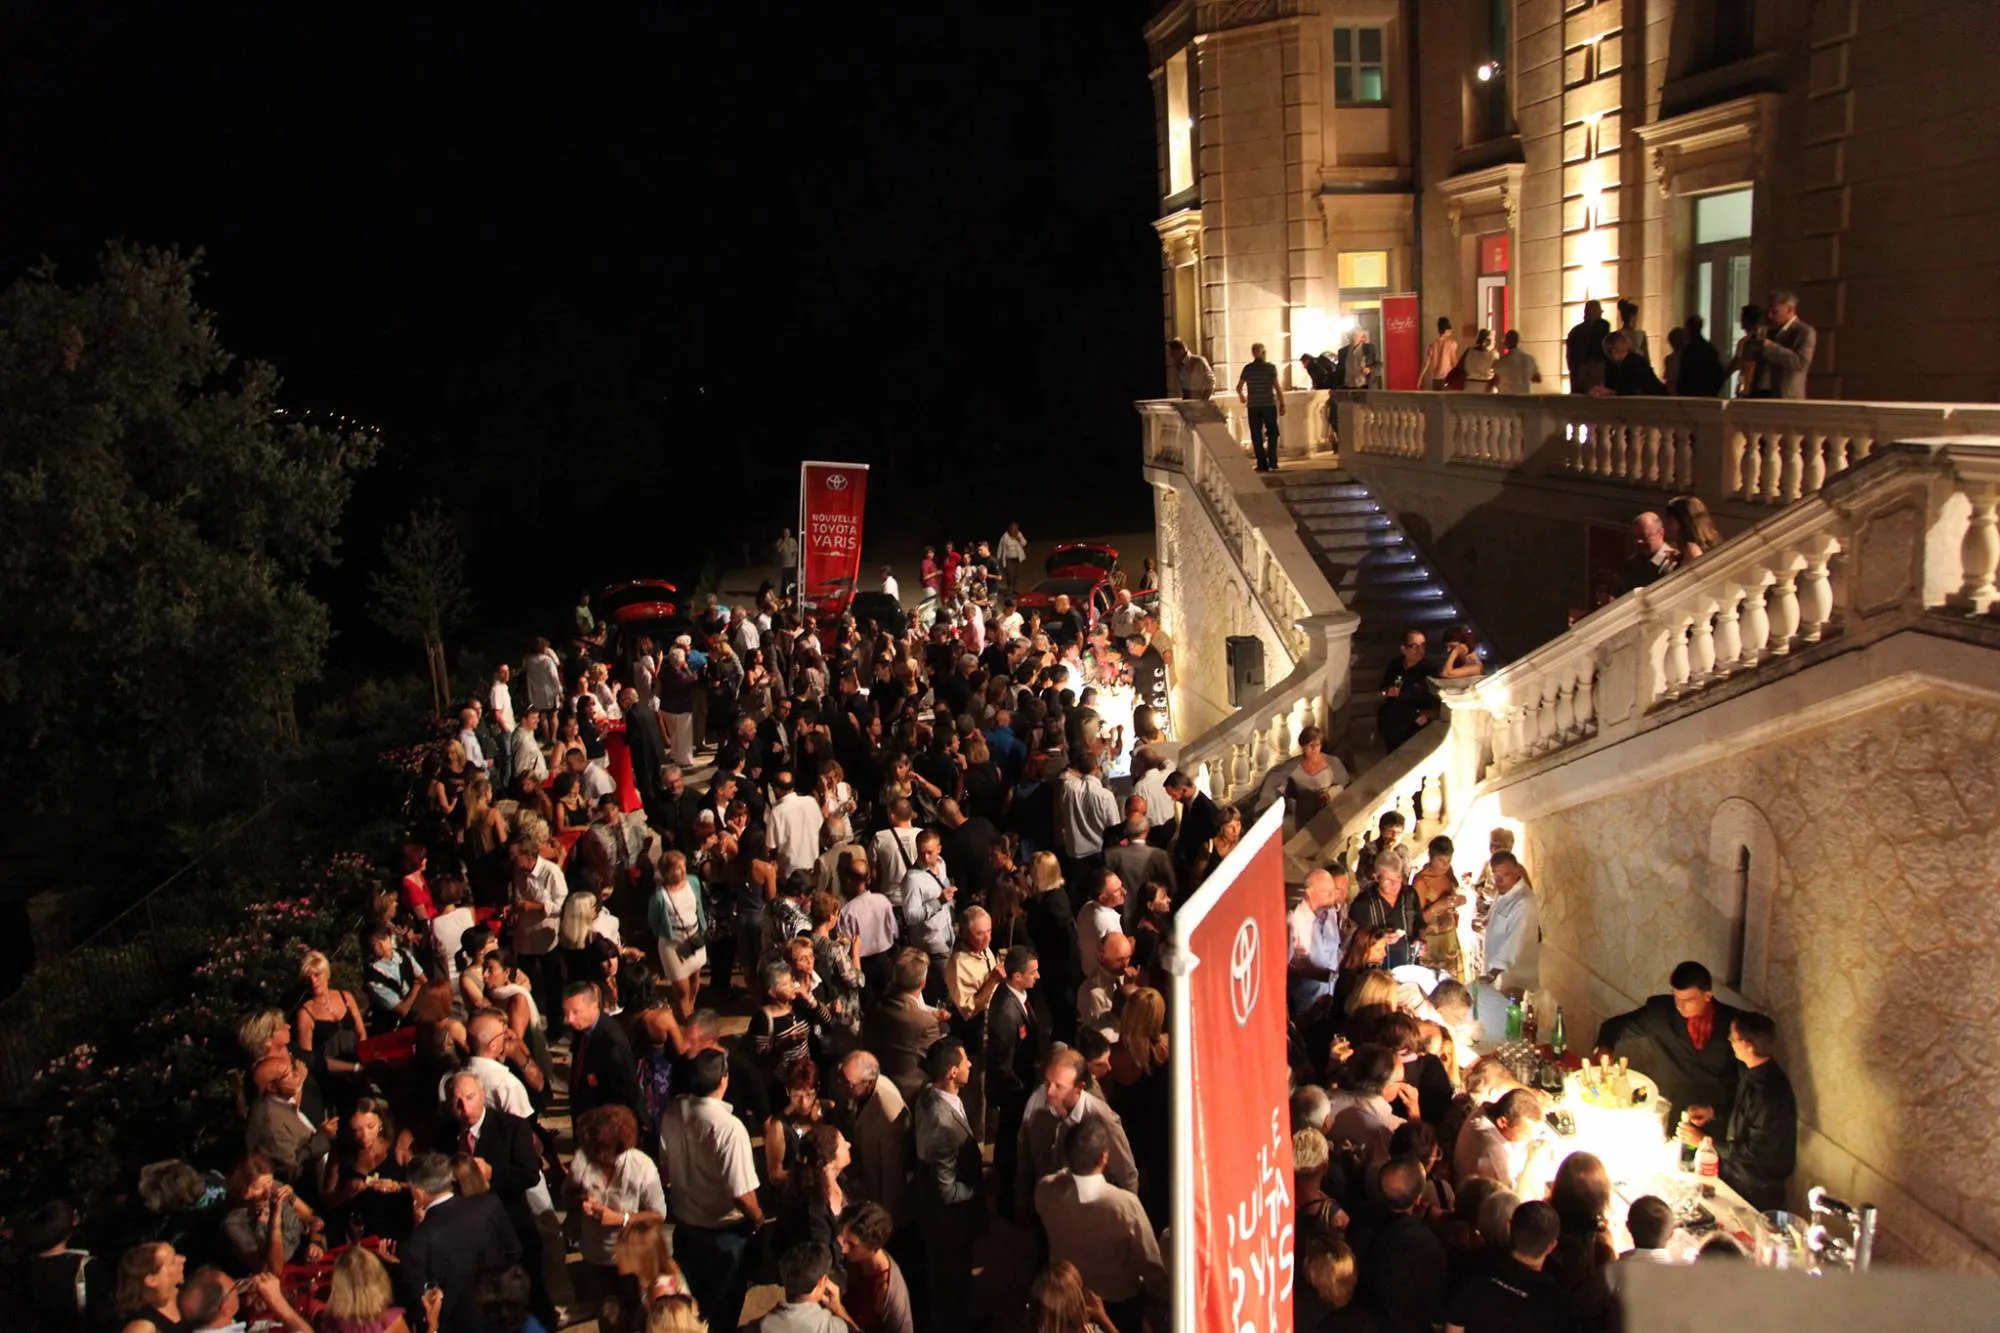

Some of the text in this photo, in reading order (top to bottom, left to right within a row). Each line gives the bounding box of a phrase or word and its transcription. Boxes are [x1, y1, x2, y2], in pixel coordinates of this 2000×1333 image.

[812, 514, 857, 523] NOUVELLE
[812, 523, 857, 535] TOYOTA
[812, 535, 857, 550] YARIS
